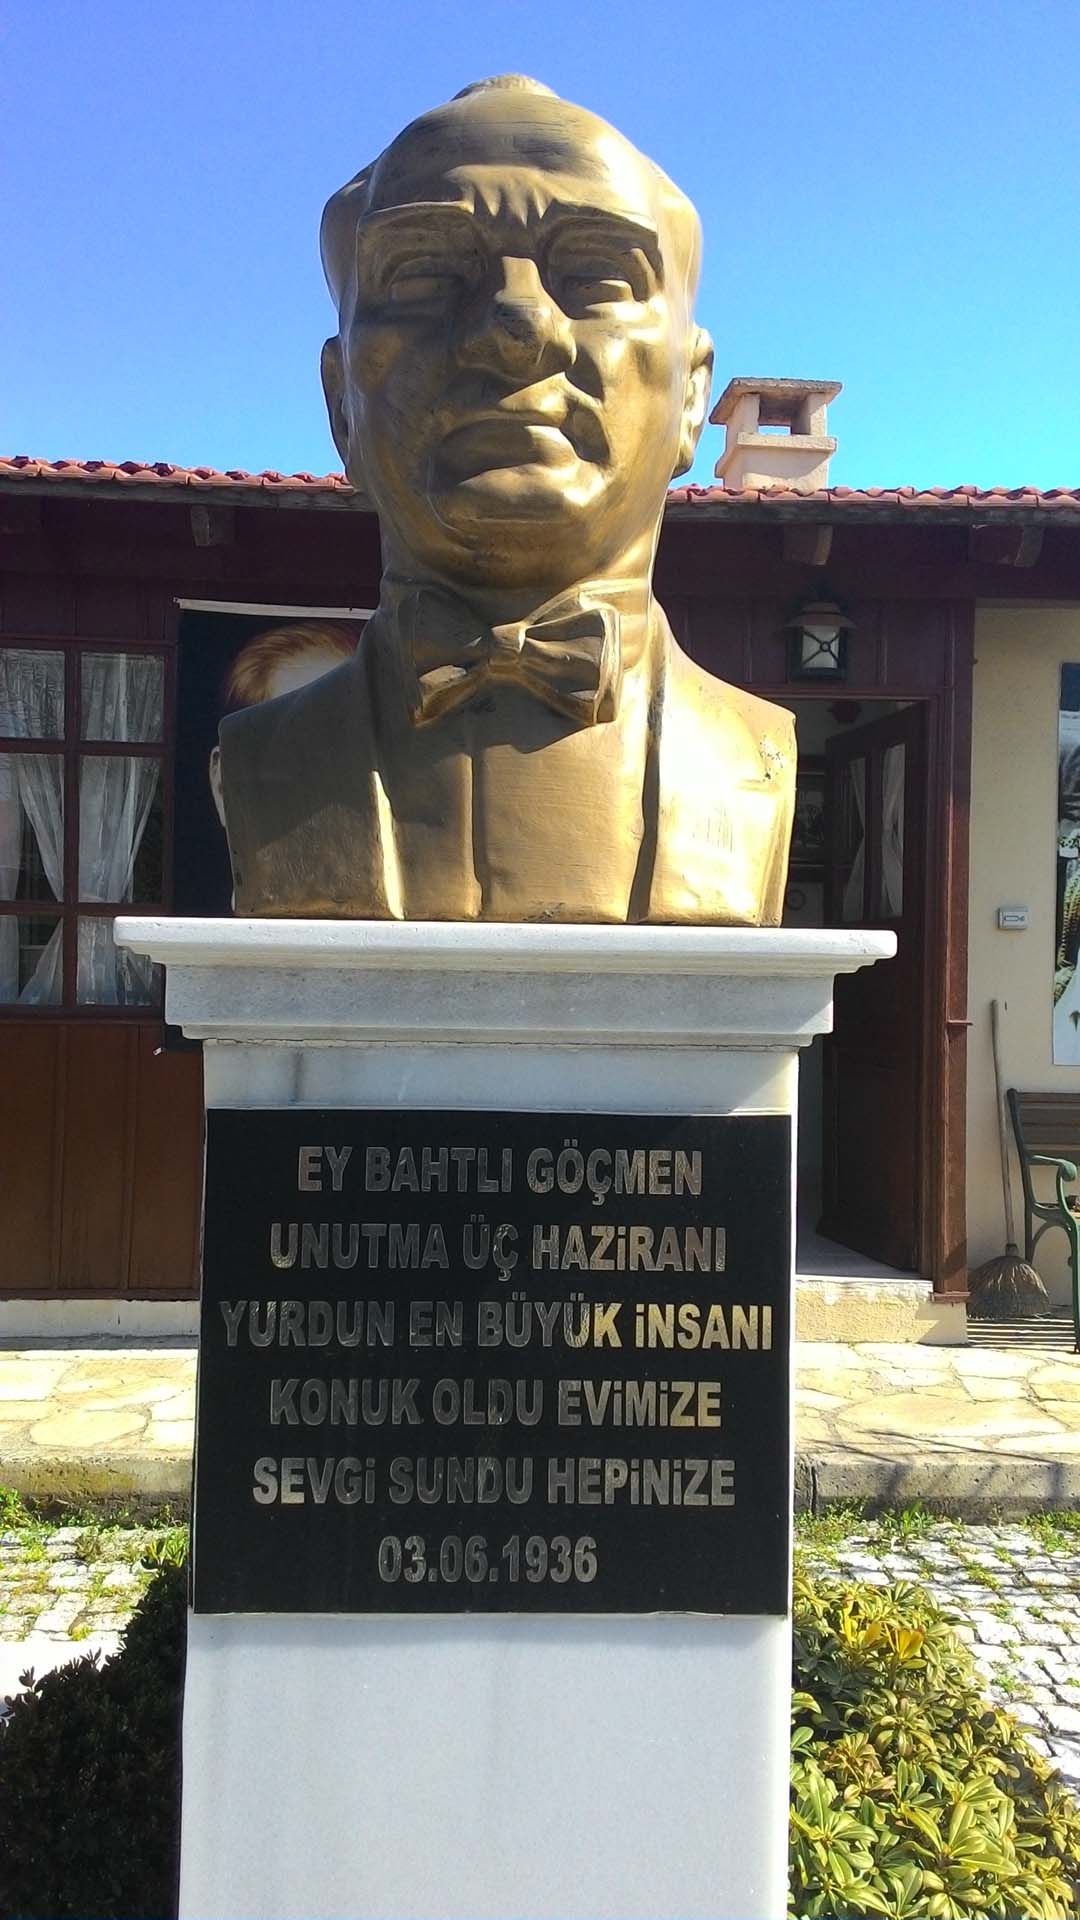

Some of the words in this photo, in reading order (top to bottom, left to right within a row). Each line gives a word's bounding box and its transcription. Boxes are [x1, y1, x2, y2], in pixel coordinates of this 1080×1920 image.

[298, 1146, 353, 1194] EY
[365, 1146, 514, 1195] BAHTLI
[526, 1138, 703, 1207] GÖÇMEN
[270, 1222, 450, 1271] UNUTMA
[463, 1214, 519, 1283] ÜÇ
[219, 1299, 396, 1349] YURDUN
[409, 1301, 465, 1349] EN
[477, 1292, 624, 1350] BÜYÜK
[270, 1379, 422, 1427] KONUK
[432, 1379, 544, 1428] OLDU
[388, 1456, 534, 1506] SUNDU
[378, 1534, 599, 1585] 03.06.1936
